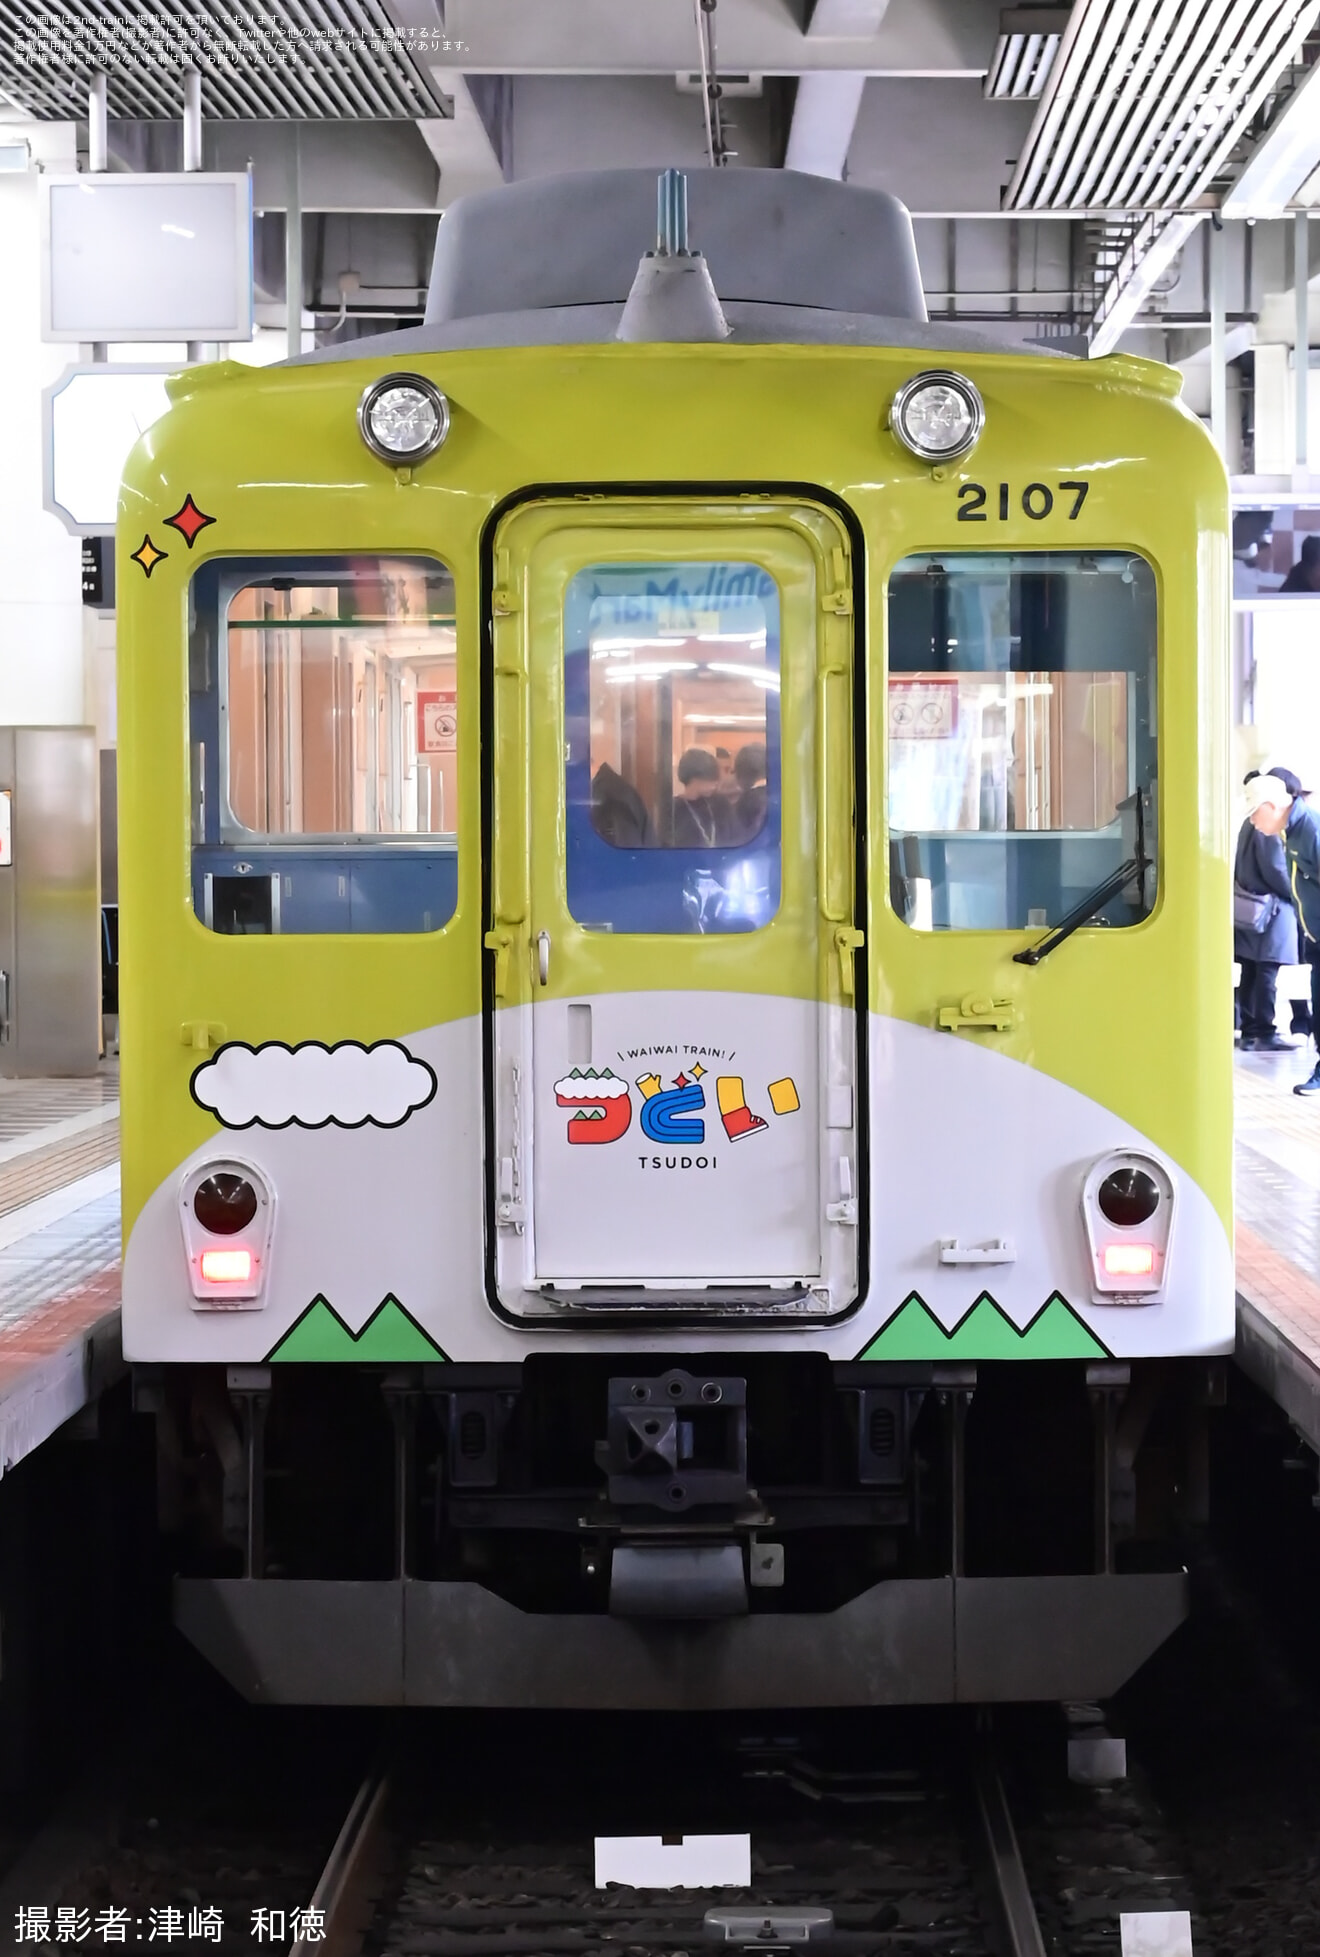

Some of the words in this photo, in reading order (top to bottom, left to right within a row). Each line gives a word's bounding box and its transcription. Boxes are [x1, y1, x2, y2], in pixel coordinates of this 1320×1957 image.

[957, 481, 1089, 521] 2107
[627, 1045, 678, 1059] WAIWAI
[683, 1045, 725, 1059] TRAIN!
[553, 1061, 800, 1145] つどい
[638, 1156, 717, 1169] TSUDOI
